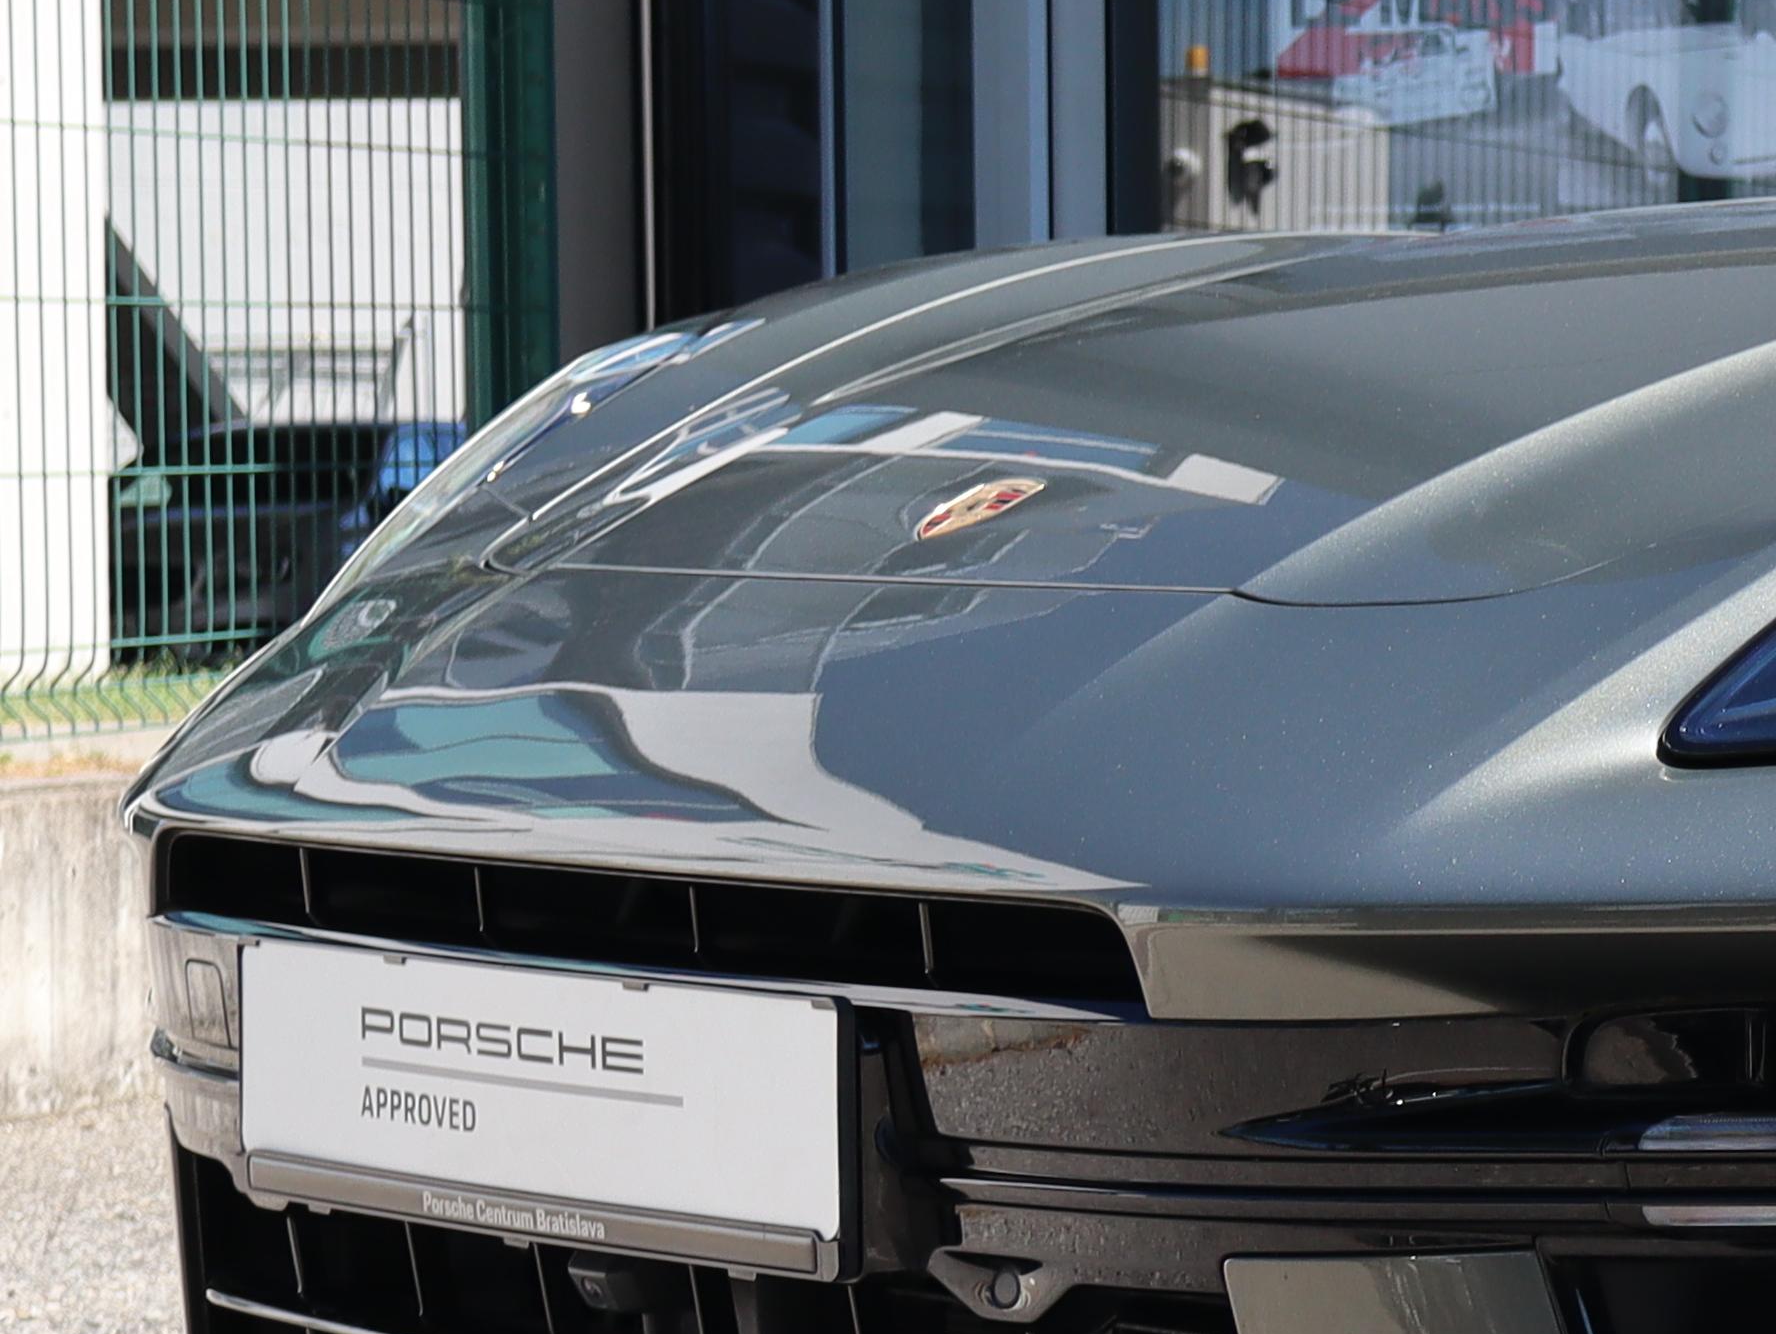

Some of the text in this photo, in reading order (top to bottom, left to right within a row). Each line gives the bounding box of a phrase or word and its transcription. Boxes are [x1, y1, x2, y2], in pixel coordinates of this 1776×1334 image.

[361, 1006, 644, 1075] PORSCHE
[361, 1085, 477, 1133] APPROVED
[422, 1191, 606, 1240] Porsche Centrum Bratislava
